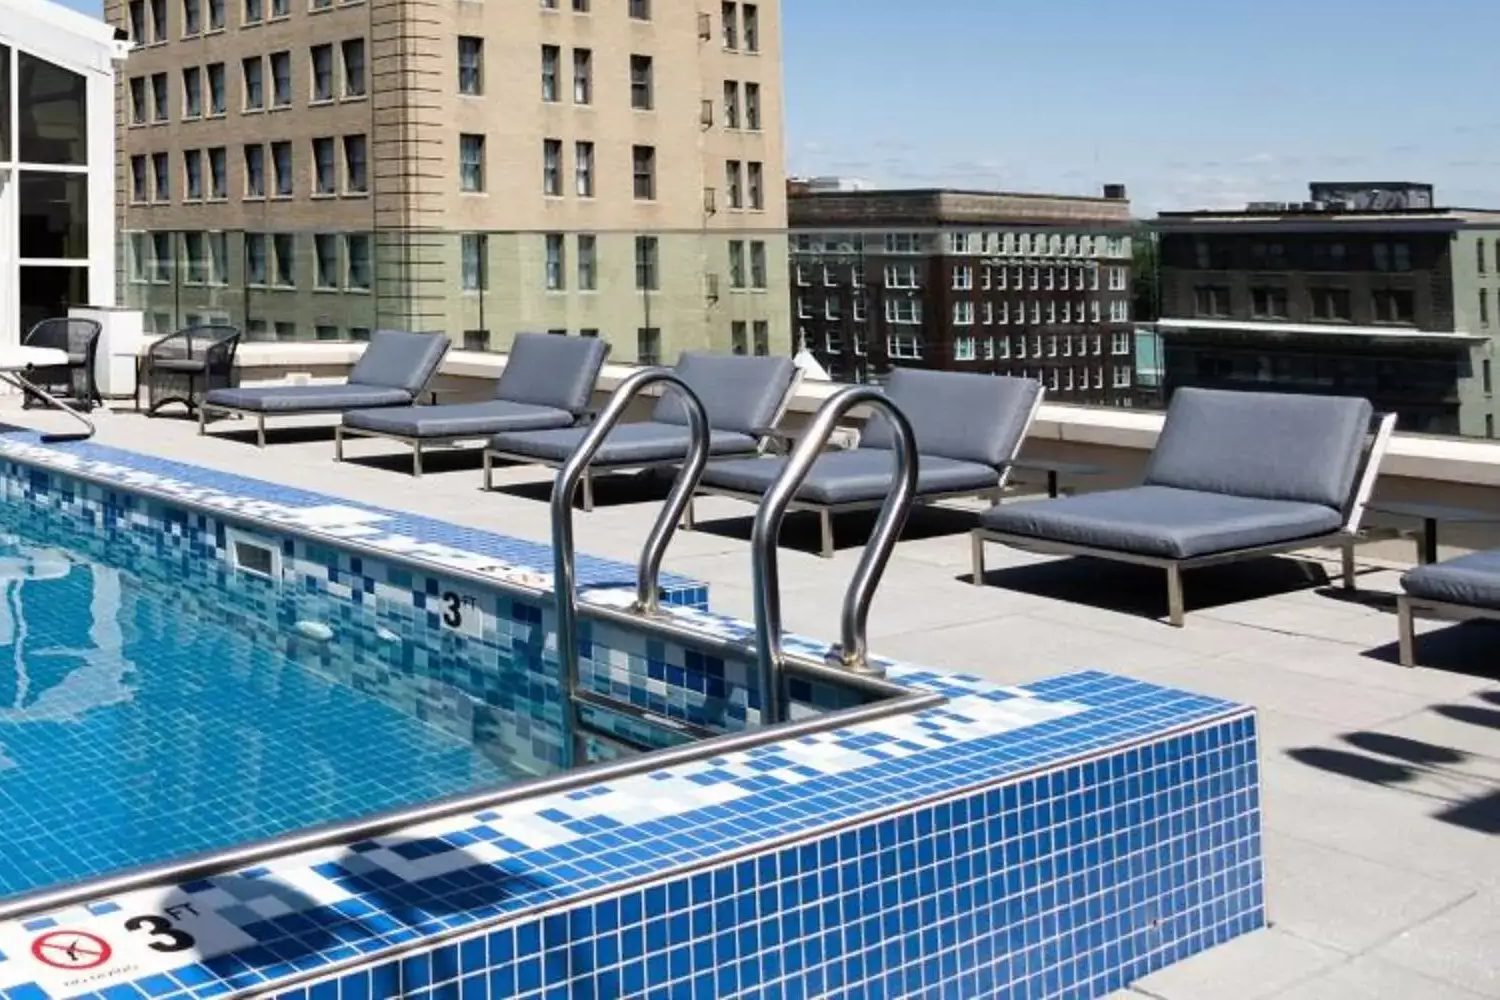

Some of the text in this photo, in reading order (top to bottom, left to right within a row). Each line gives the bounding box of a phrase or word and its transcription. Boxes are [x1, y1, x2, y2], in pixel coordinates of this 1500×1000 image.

[443, 591, 462, 628] 3
[124, 902, 200, 953] 3 FT
